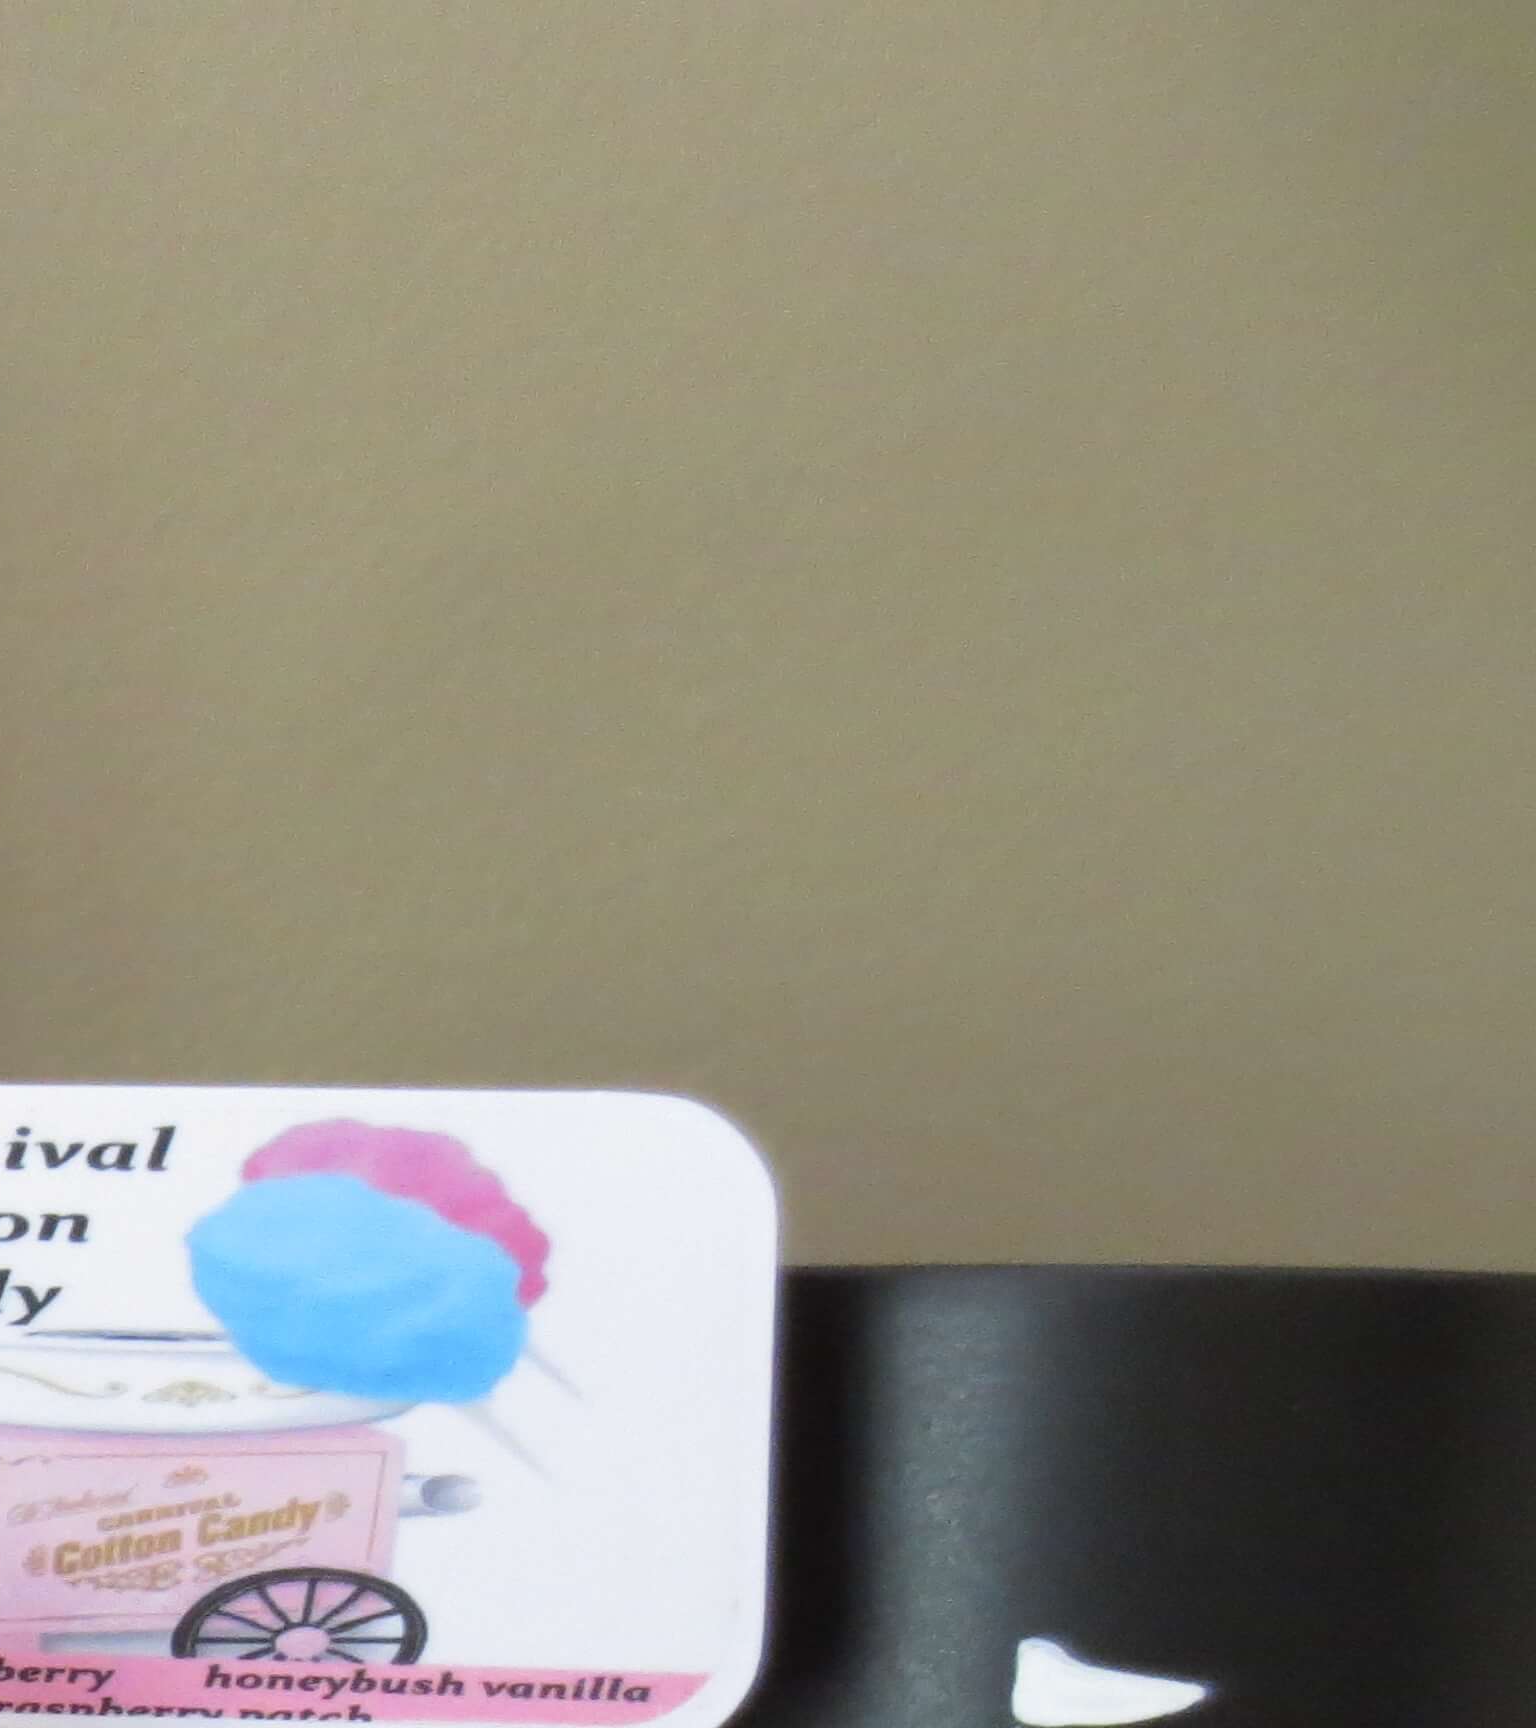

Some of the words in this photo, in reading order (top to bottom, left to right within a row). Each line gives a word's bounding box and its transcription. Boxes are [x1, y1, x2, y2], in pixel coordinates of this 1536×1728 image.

[53, 1529, 184, 1576] Cotton
[197, 1497, 322, 1547] Candy
[203, 1662, 466, 1701] honeybush
[483, 1676, 652, 1703] vanilla
